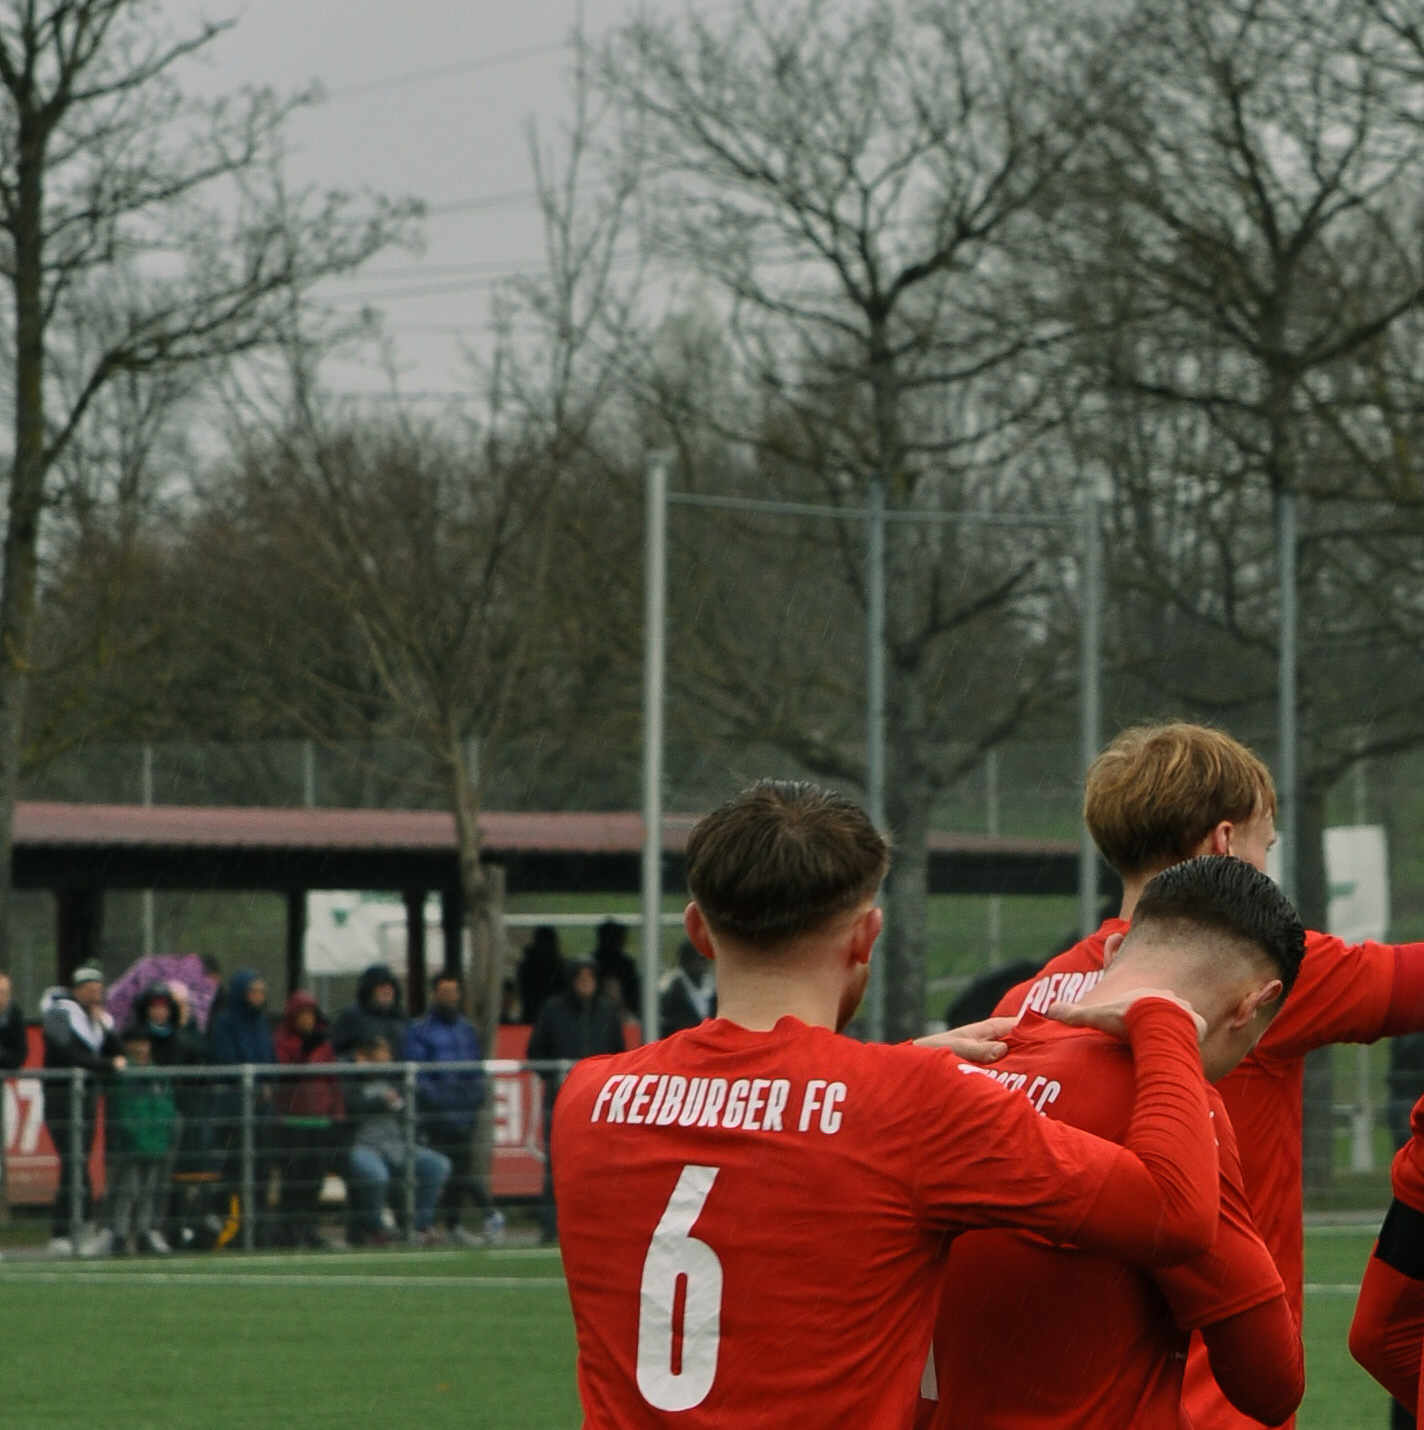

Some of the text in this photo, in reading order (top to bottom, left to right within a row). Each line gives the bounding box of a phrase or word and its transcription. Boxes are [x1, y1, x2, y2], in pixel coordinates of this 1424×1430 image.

[590, 1074, 789, 1133] FREIBURGER
[798, 1079, 848, 1135] FC
[635, 1164, 724, 1412] 6
